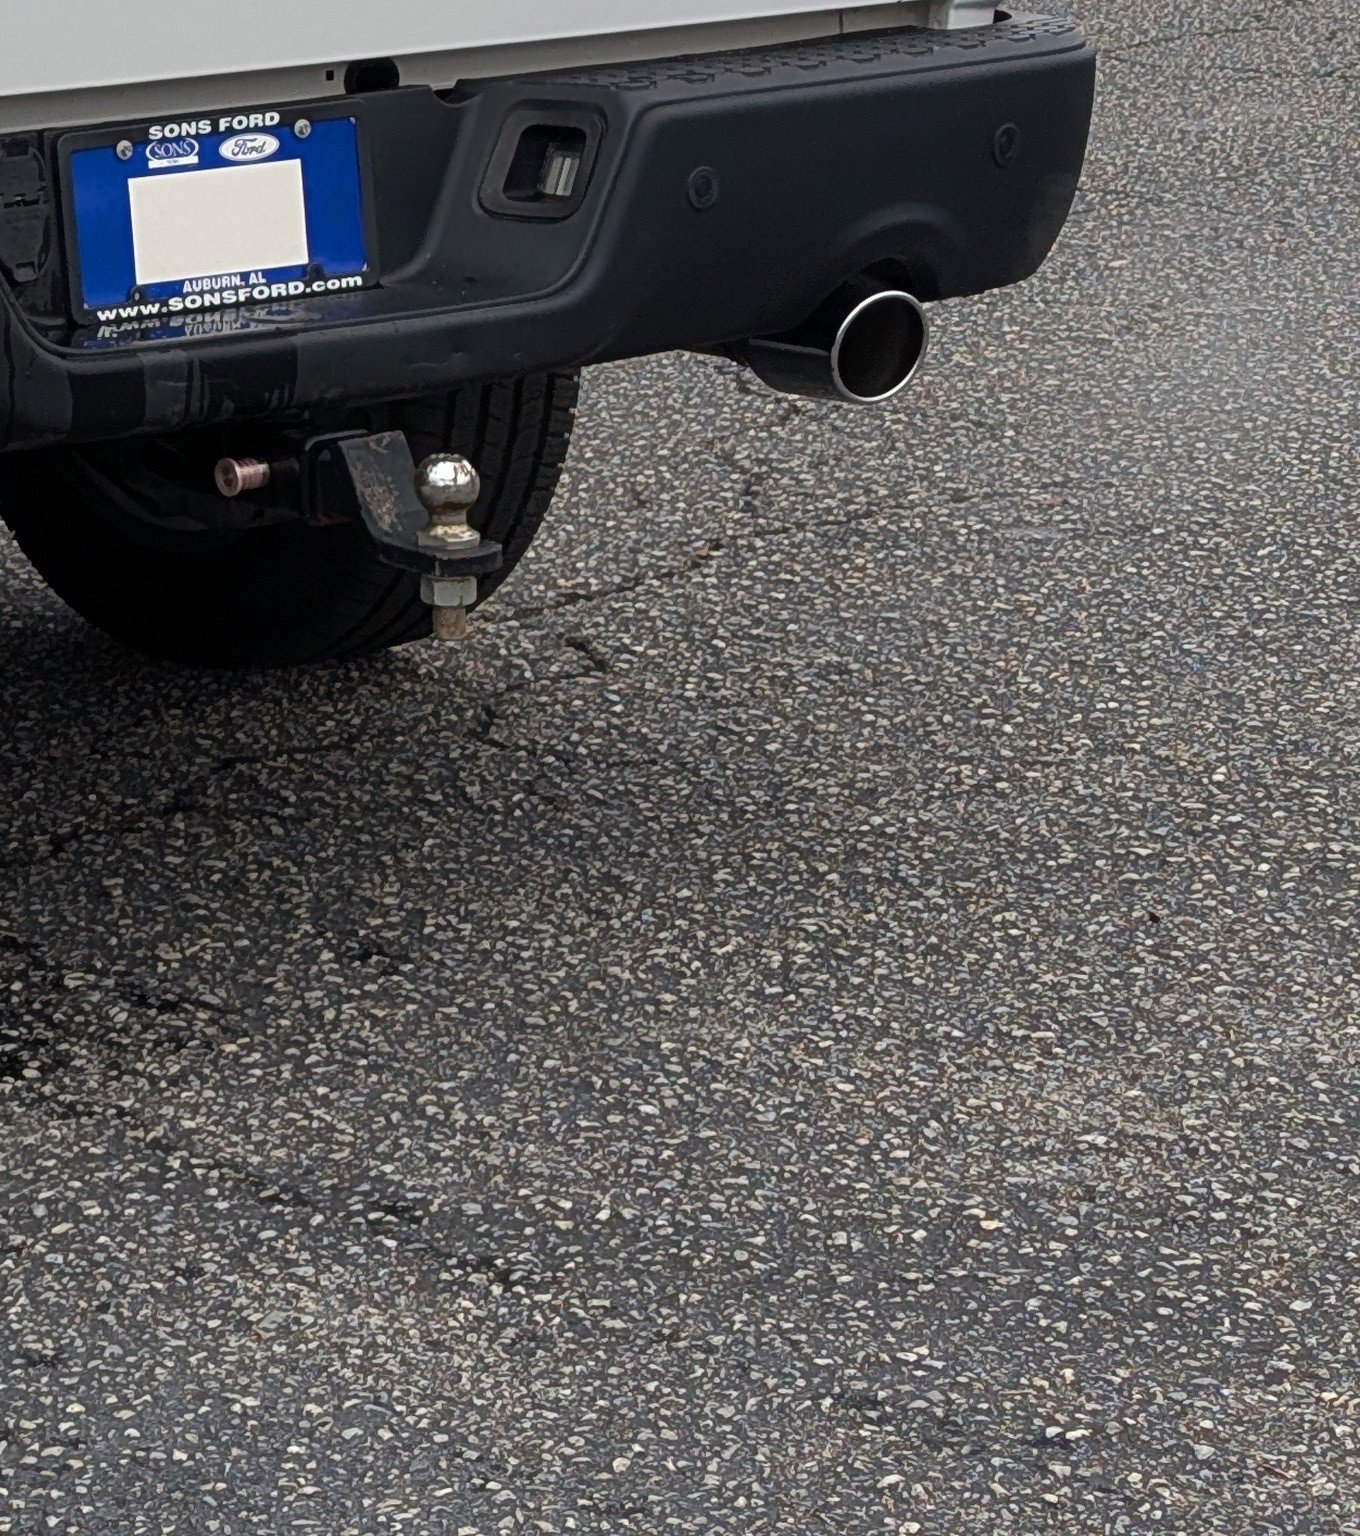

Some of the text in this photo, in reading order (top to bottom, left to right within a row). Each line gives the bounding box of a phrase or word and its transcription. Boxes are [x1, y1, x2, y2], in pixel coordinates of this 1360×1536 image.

[148, 111, 280, 140] SONS FORD
[154, 138, 267, 158] SONS Ford
[249, 271, 267, 285] AL
[97, 274, 363, 322] www.SONSFORD.com
